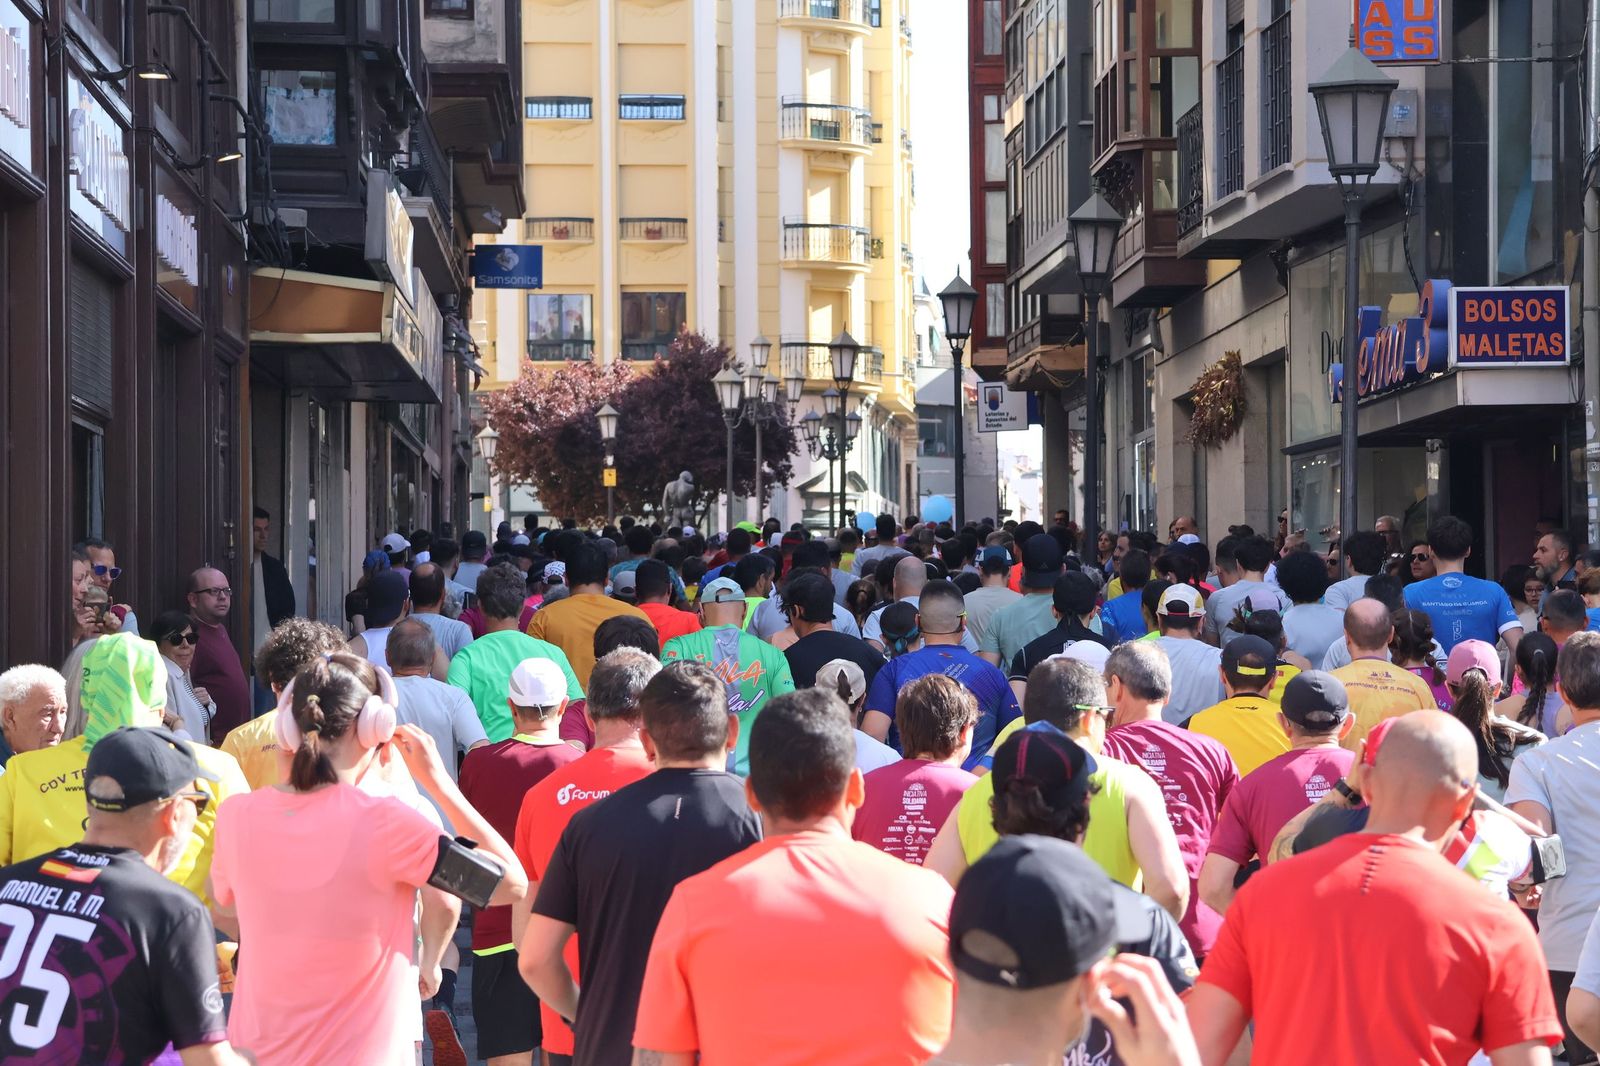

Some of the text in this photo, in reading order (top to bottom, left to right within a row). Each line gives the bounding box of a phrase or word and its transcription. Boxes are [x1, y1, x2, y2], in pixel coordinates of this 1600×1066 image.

[479, 274, 538, 285] Samsonite
[1464, 298, 1557, 323] BOLSOS
[1416, 279, 1441, 374] 3
[1459, 332, 1564, 357] MALETAS
[39, 774, 66, 793] CDV
[902, 797, 927, 805] SOLIDARIA
[0, 879, 105, 919] MANUEL R. M.
